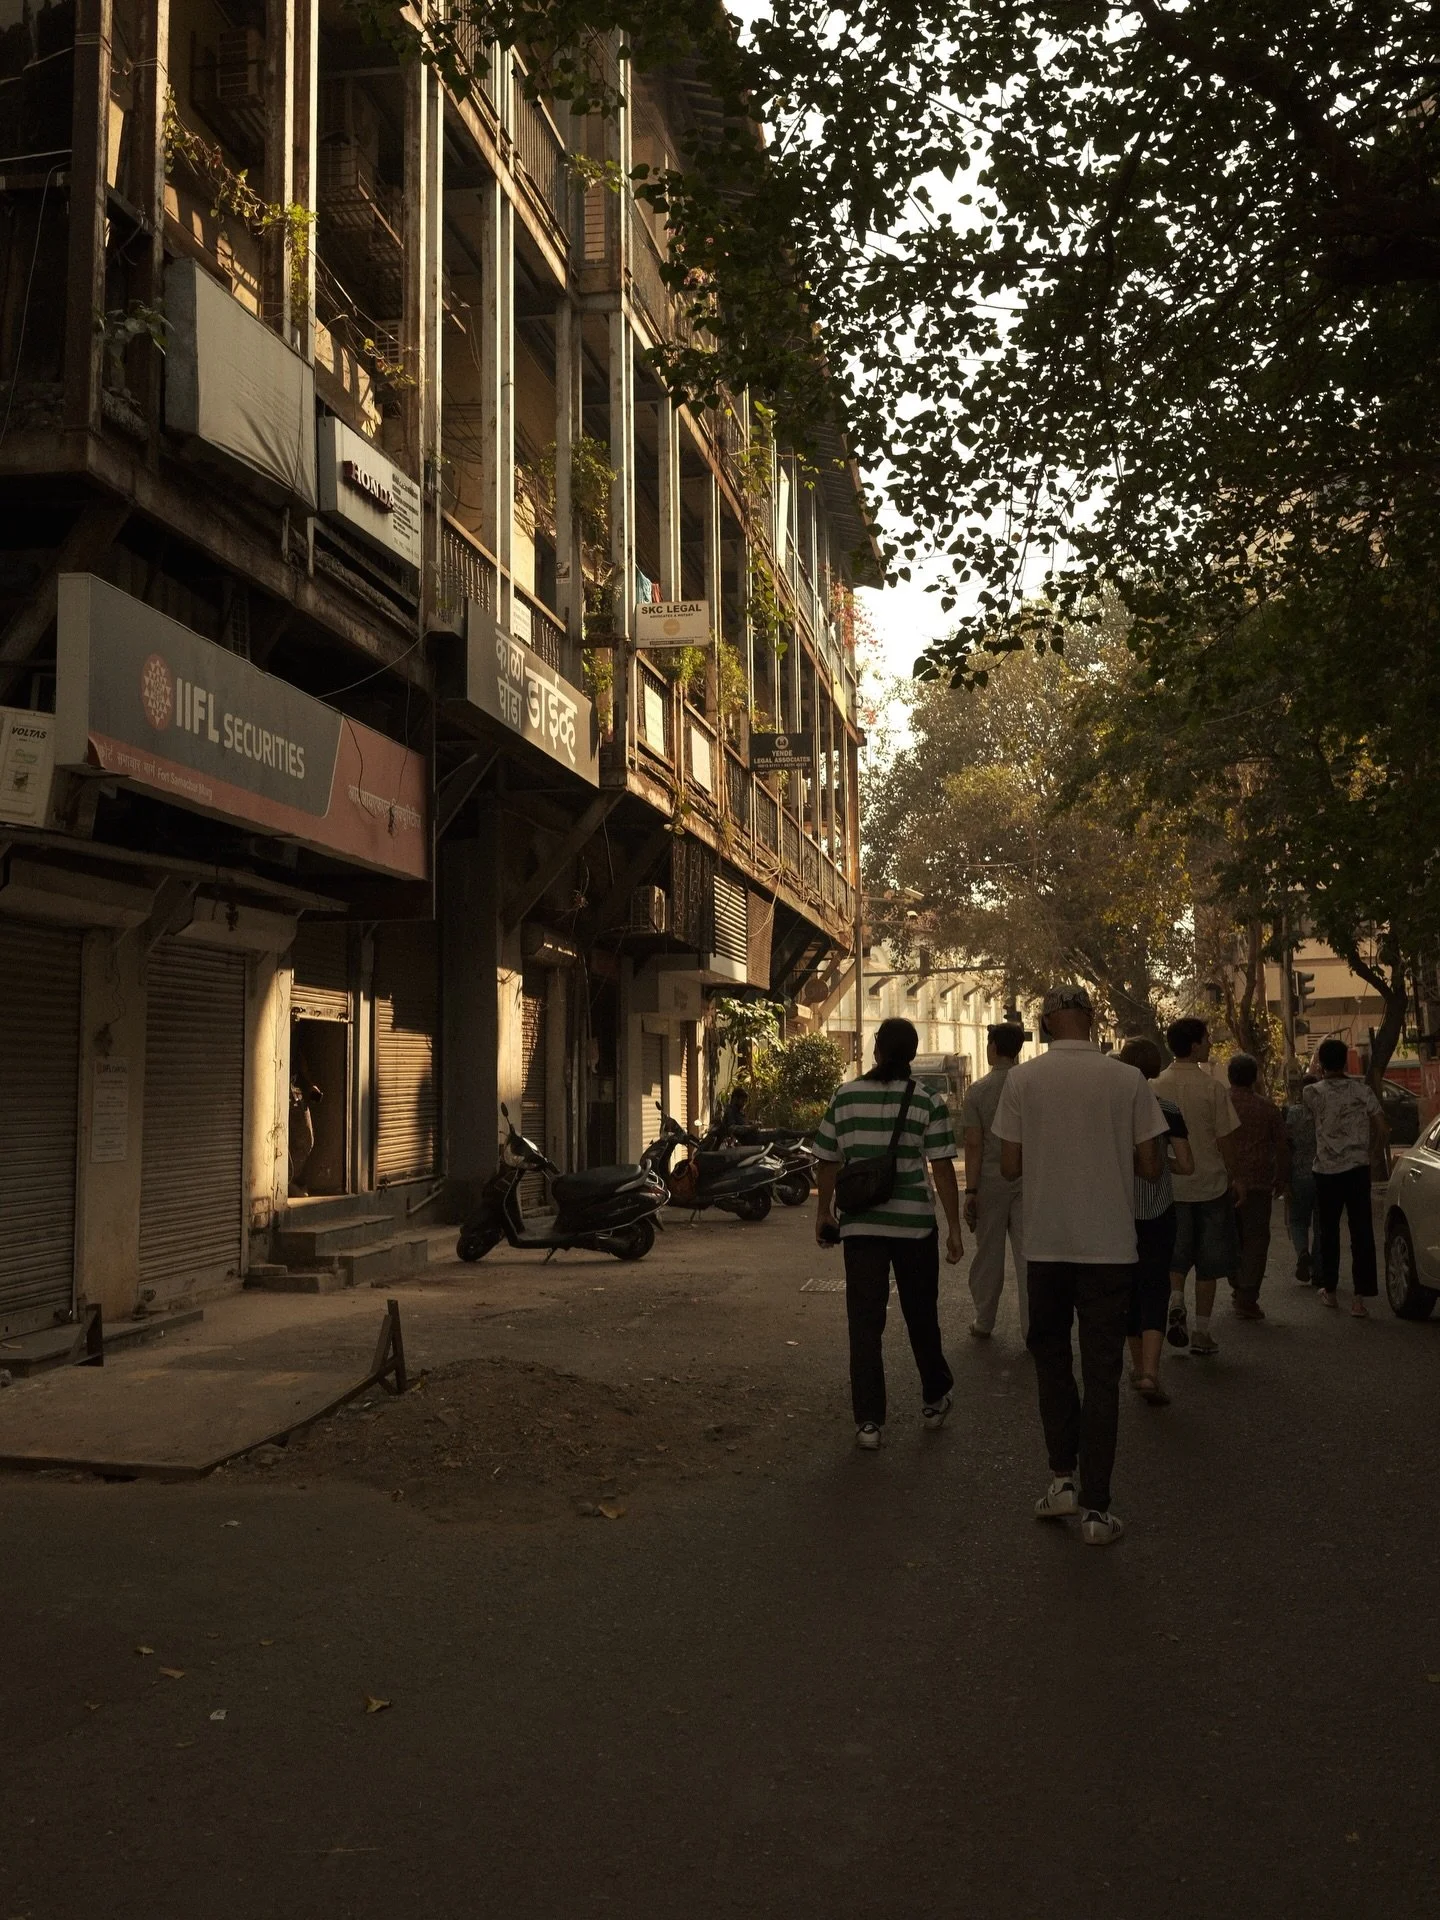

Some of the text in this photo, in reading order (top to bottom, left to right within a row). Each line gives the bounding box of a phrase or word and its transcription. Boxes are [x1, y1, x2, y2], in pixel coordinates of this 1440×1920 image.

[347, 461, 395, 511] HONDA
[641, 604, 702, 615] SKC LEGAL
[494, 628, 526, 686] काळा
[497, 671, 523, 730] घोडा
[11, 727, 48, 739] VOLTAS
[176, 677, 305, 780] IIFL SECURITIES
